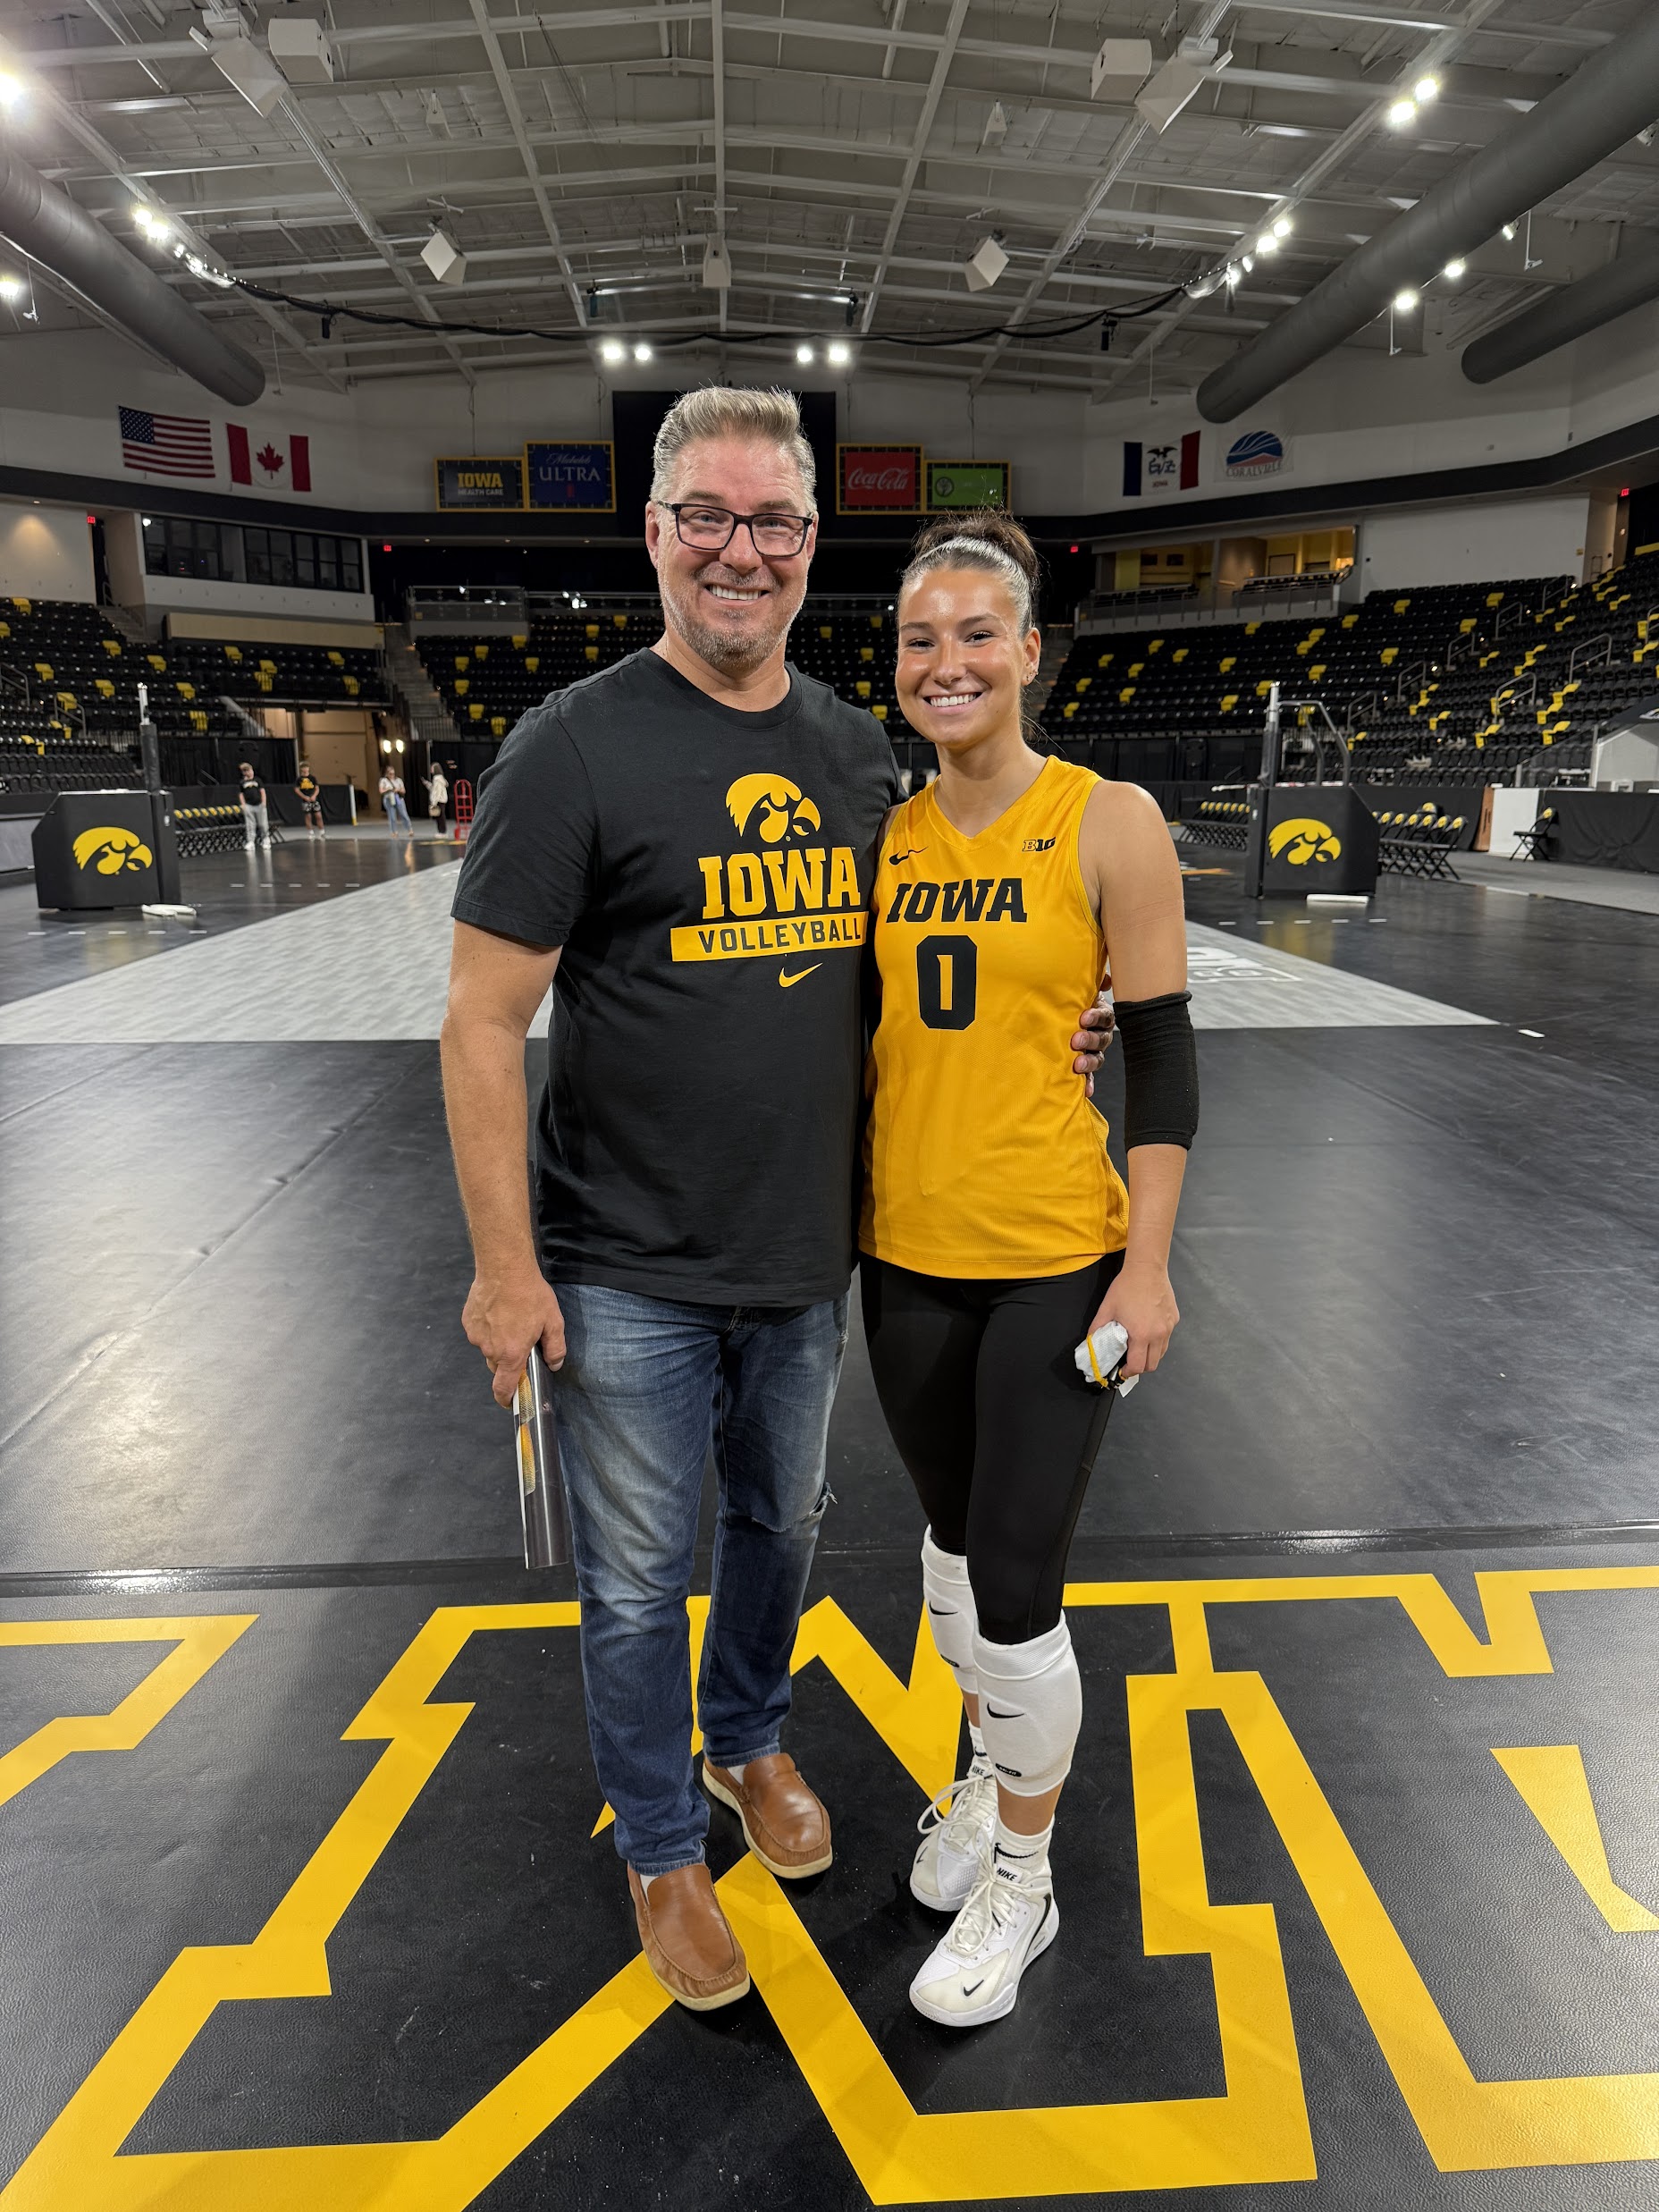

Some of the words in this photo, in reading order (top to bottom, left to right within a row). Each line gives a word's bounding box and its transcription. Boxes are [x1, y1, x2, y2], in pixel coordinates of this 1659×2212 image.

[457, 472, 504, 488] IOWA
[539, 467, 602, 481] ULTRA
[457, 487, 484, 496] HEALTH
[485, 487, 504, 495] CARE
[697, 847, 862, 920] IOWA
[886, 877, 1028, 924] IOWA
[697, 917, 862, 954] VOLLEYBALL
[916, 934, 978, 1031] 0
[971, 1764, 985, 1777] NIKE
[996, 1867, 1018, 1882] NIKE
